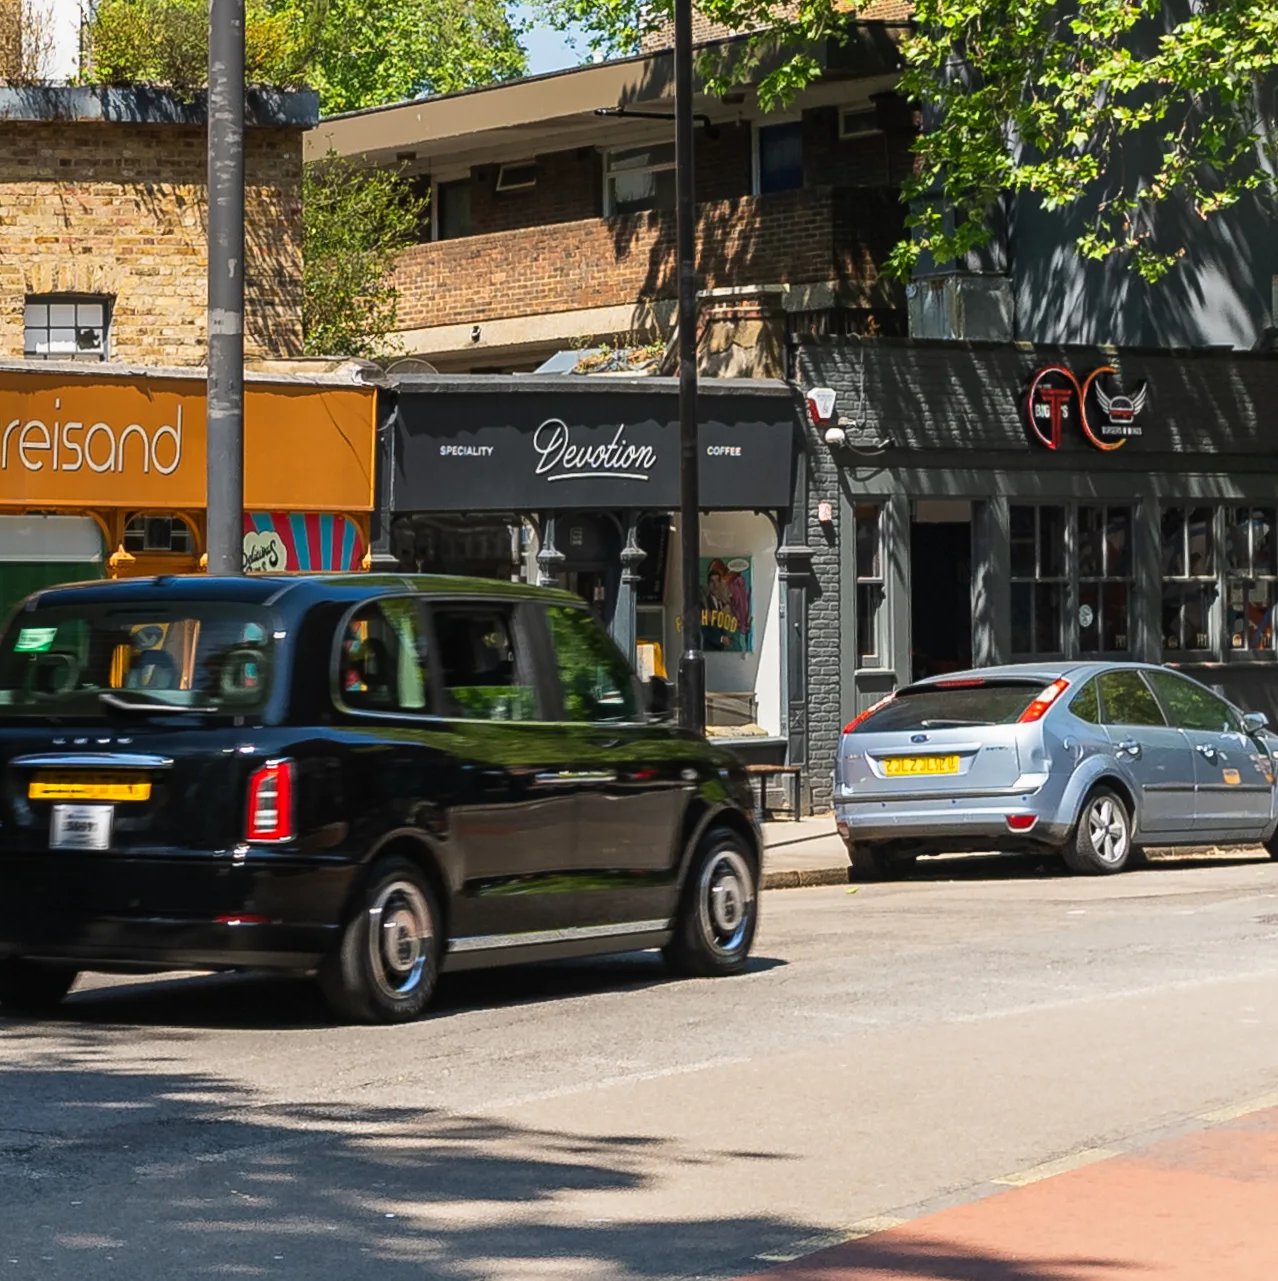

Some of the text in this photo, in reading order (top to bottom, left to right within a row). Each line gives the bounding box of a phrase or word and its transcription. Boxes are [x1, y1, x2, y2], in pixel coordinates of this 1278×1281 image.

[1035, 404, 1051, 419] BIG
[439, 445, 494, 457] SPECIALITY
[533, 418, 657, 475] Devotion
[706, 446, 742, 457] COFFEE
[710, 610, 738, 633] FOOD
